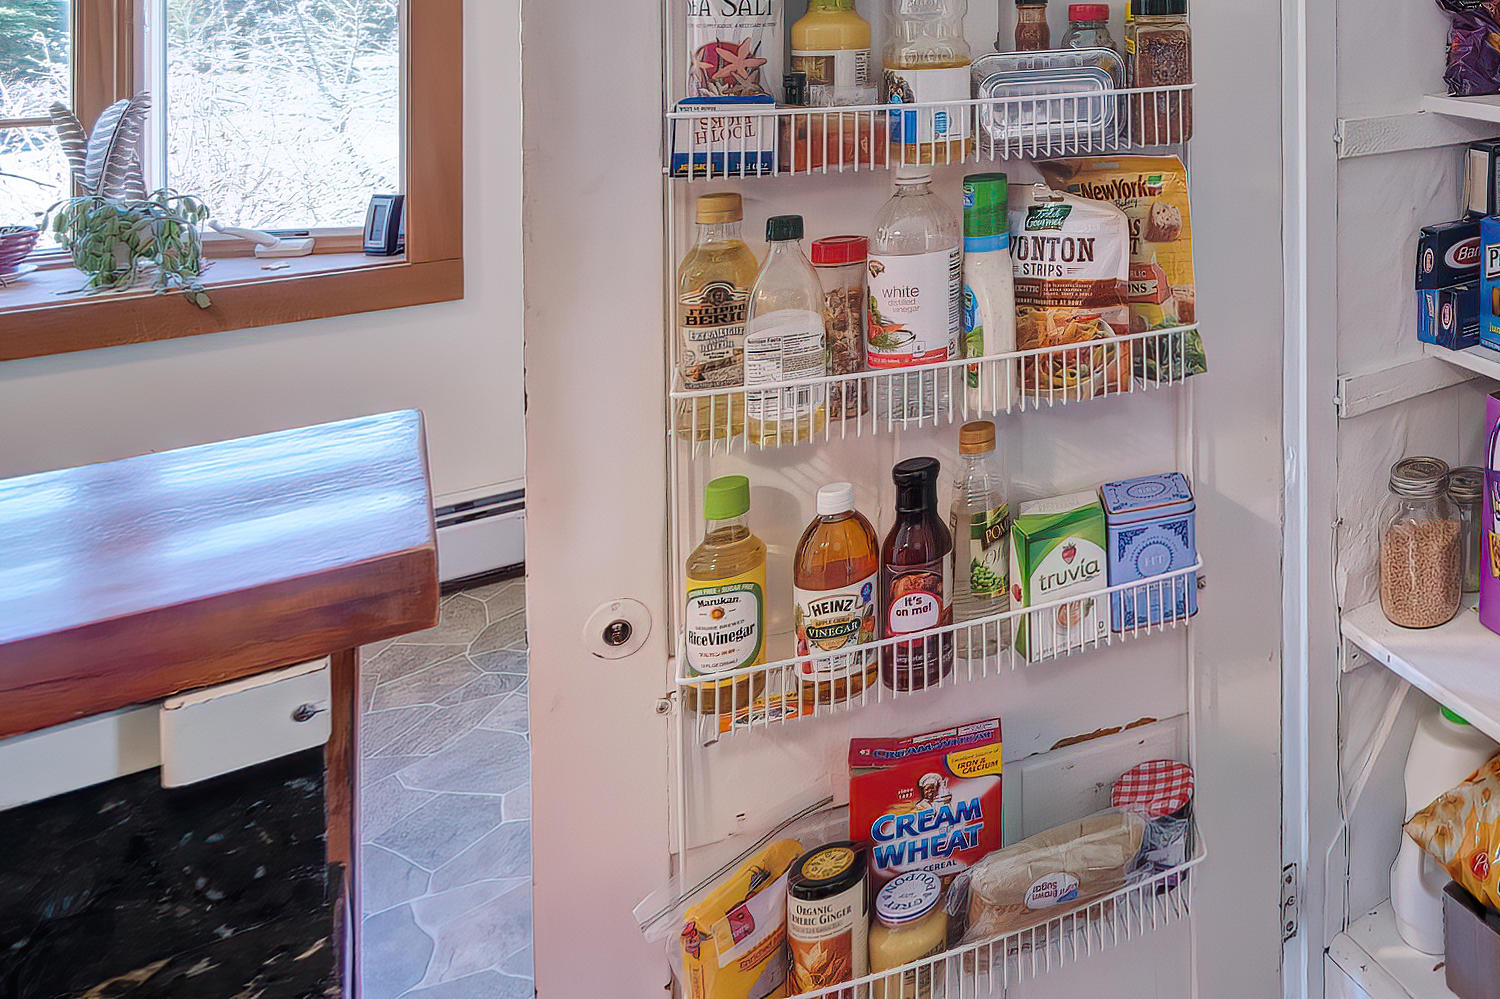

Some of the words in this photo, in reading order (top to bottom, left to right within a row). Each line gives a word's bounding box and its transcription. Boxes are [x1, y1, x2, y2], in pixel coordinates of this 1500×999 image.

[1023, 263, 1063, 277] STRIPS
[882, 285, 920, 298] white
[698, 596, 740, 608] Marukan
[812, 600, 853, 617] HEINZ
[896, 609, 909, 617] on
[808, 621, 858, 638] VINEGAR
[957, 759, 979, 770] IRON
[962, 761, 999, 775] CALCIUM
[871, 797, 984, 843] CREAM
[873, 821, 985, 870] WHEAT
[796, 904, 833, 915] ORGANIC
[819, 905, 853, 925] GINGER
